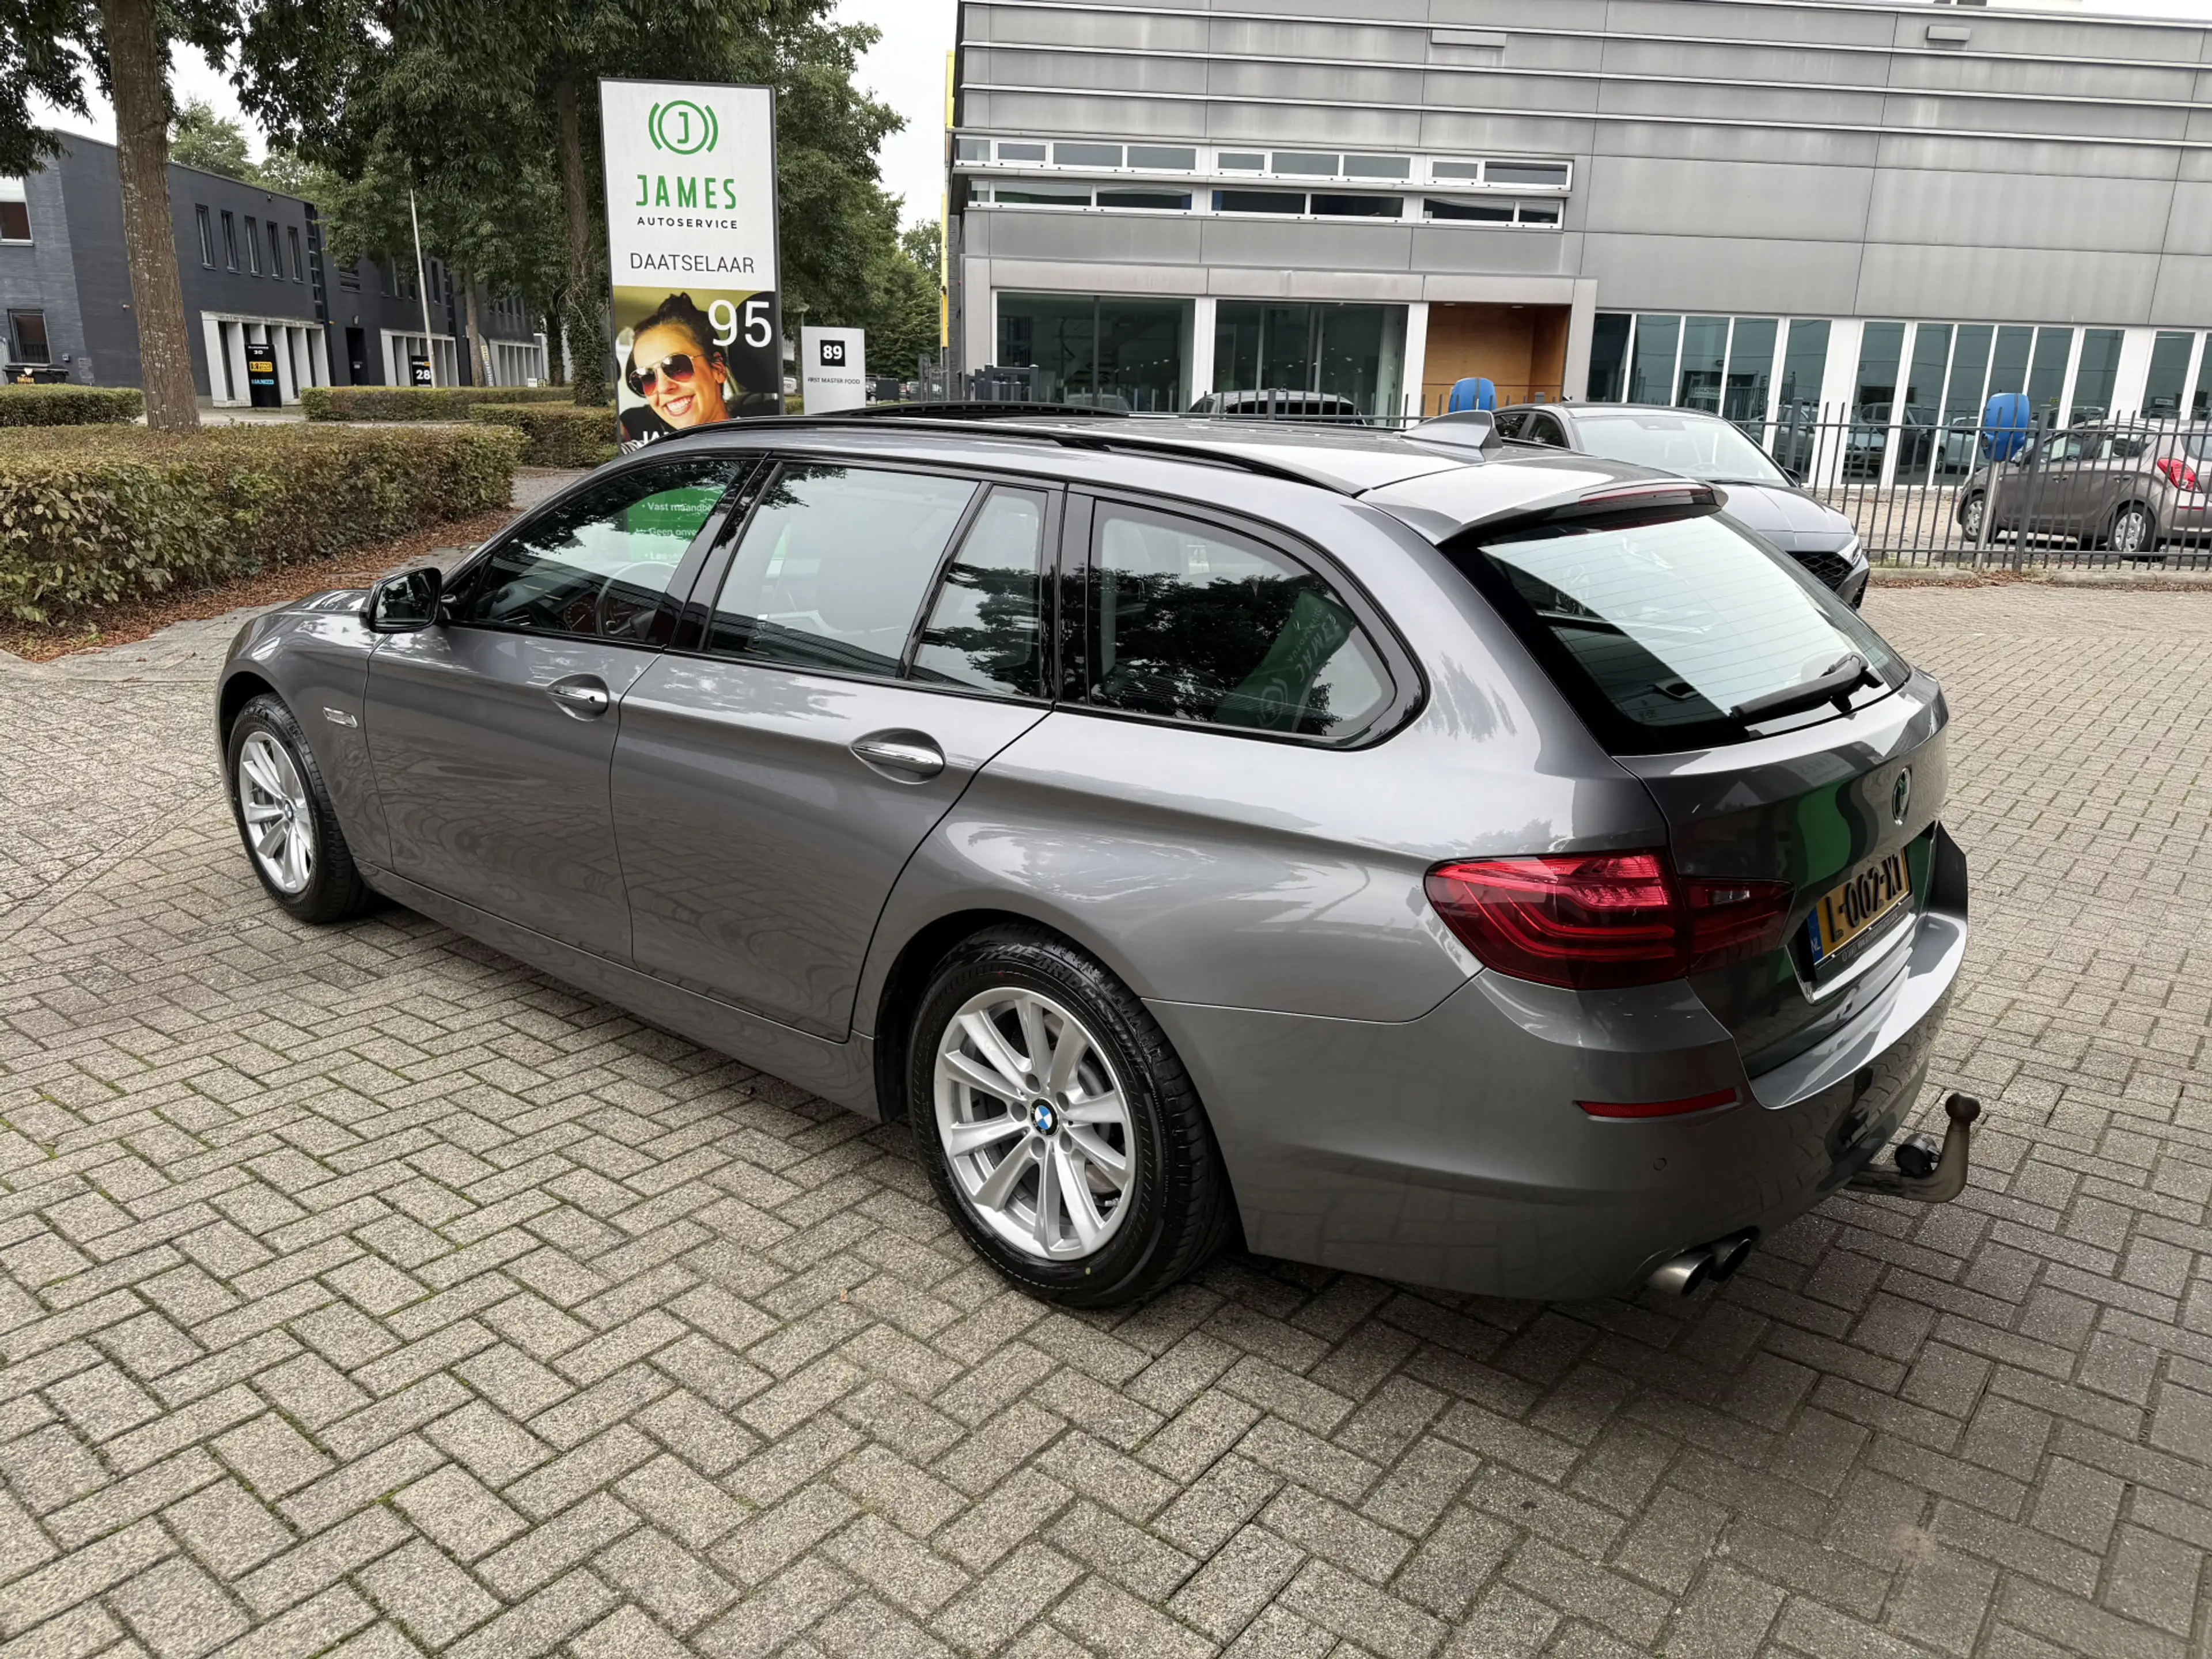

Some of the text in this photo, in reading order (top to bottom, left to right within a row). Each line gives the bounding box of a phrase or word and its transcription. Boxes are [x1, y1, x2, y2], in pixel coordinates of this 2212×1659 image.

[635, 174, 736, 209] JAMES
[637, 217, 737, 229] AUTOSERVICE
[630, 252, 754, 274] DAATSELAAR
[708, 299, 772, 347] 95
[823, 344, 843, 360] 89
[416, 369, 431, 380] 28
[647, 502, 669, 511] Vast
[1810, 937, 1821, 952] NL
